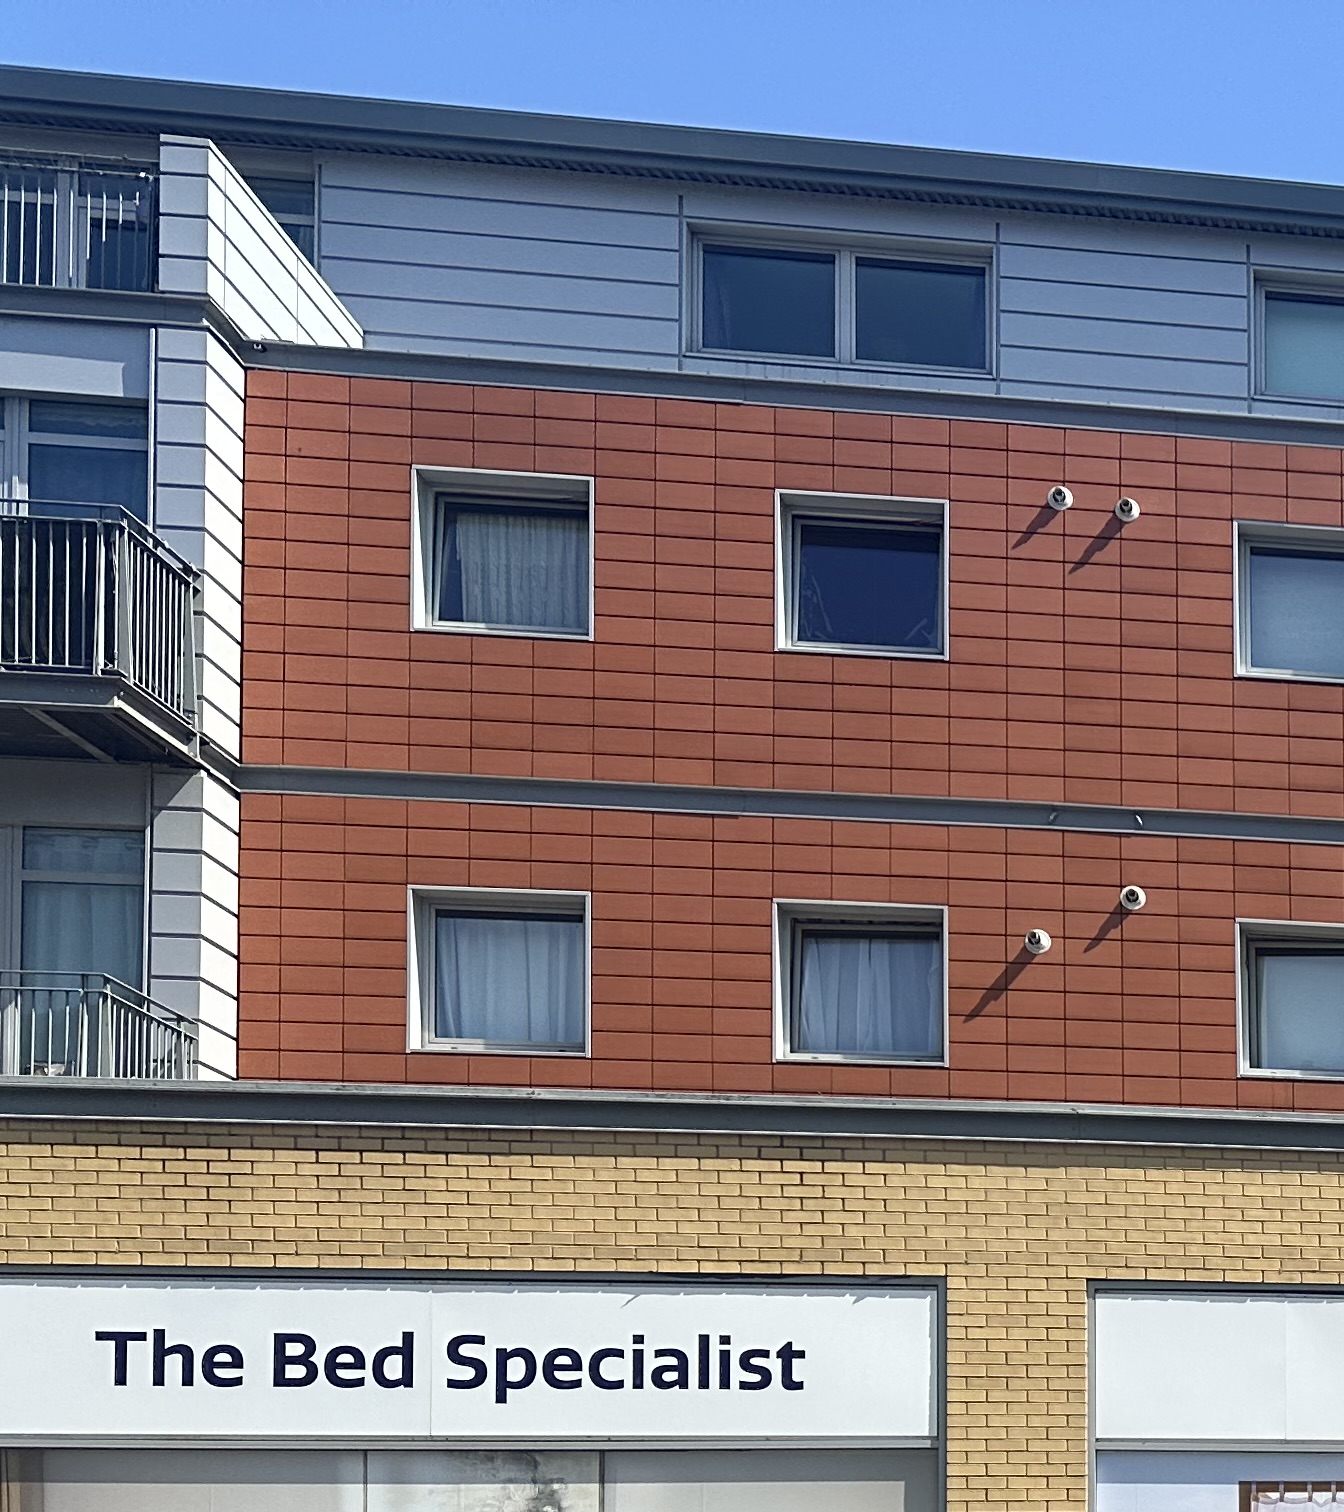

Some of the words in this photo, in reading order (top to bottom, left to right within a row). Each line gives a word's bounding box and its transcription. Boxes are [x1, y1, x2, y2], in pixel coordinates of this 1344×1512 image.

[94, 1328, 244, 1389] The
[272, 1331, 415, 1390] Bed
[446, 1333, 806, 1405] Specialist
